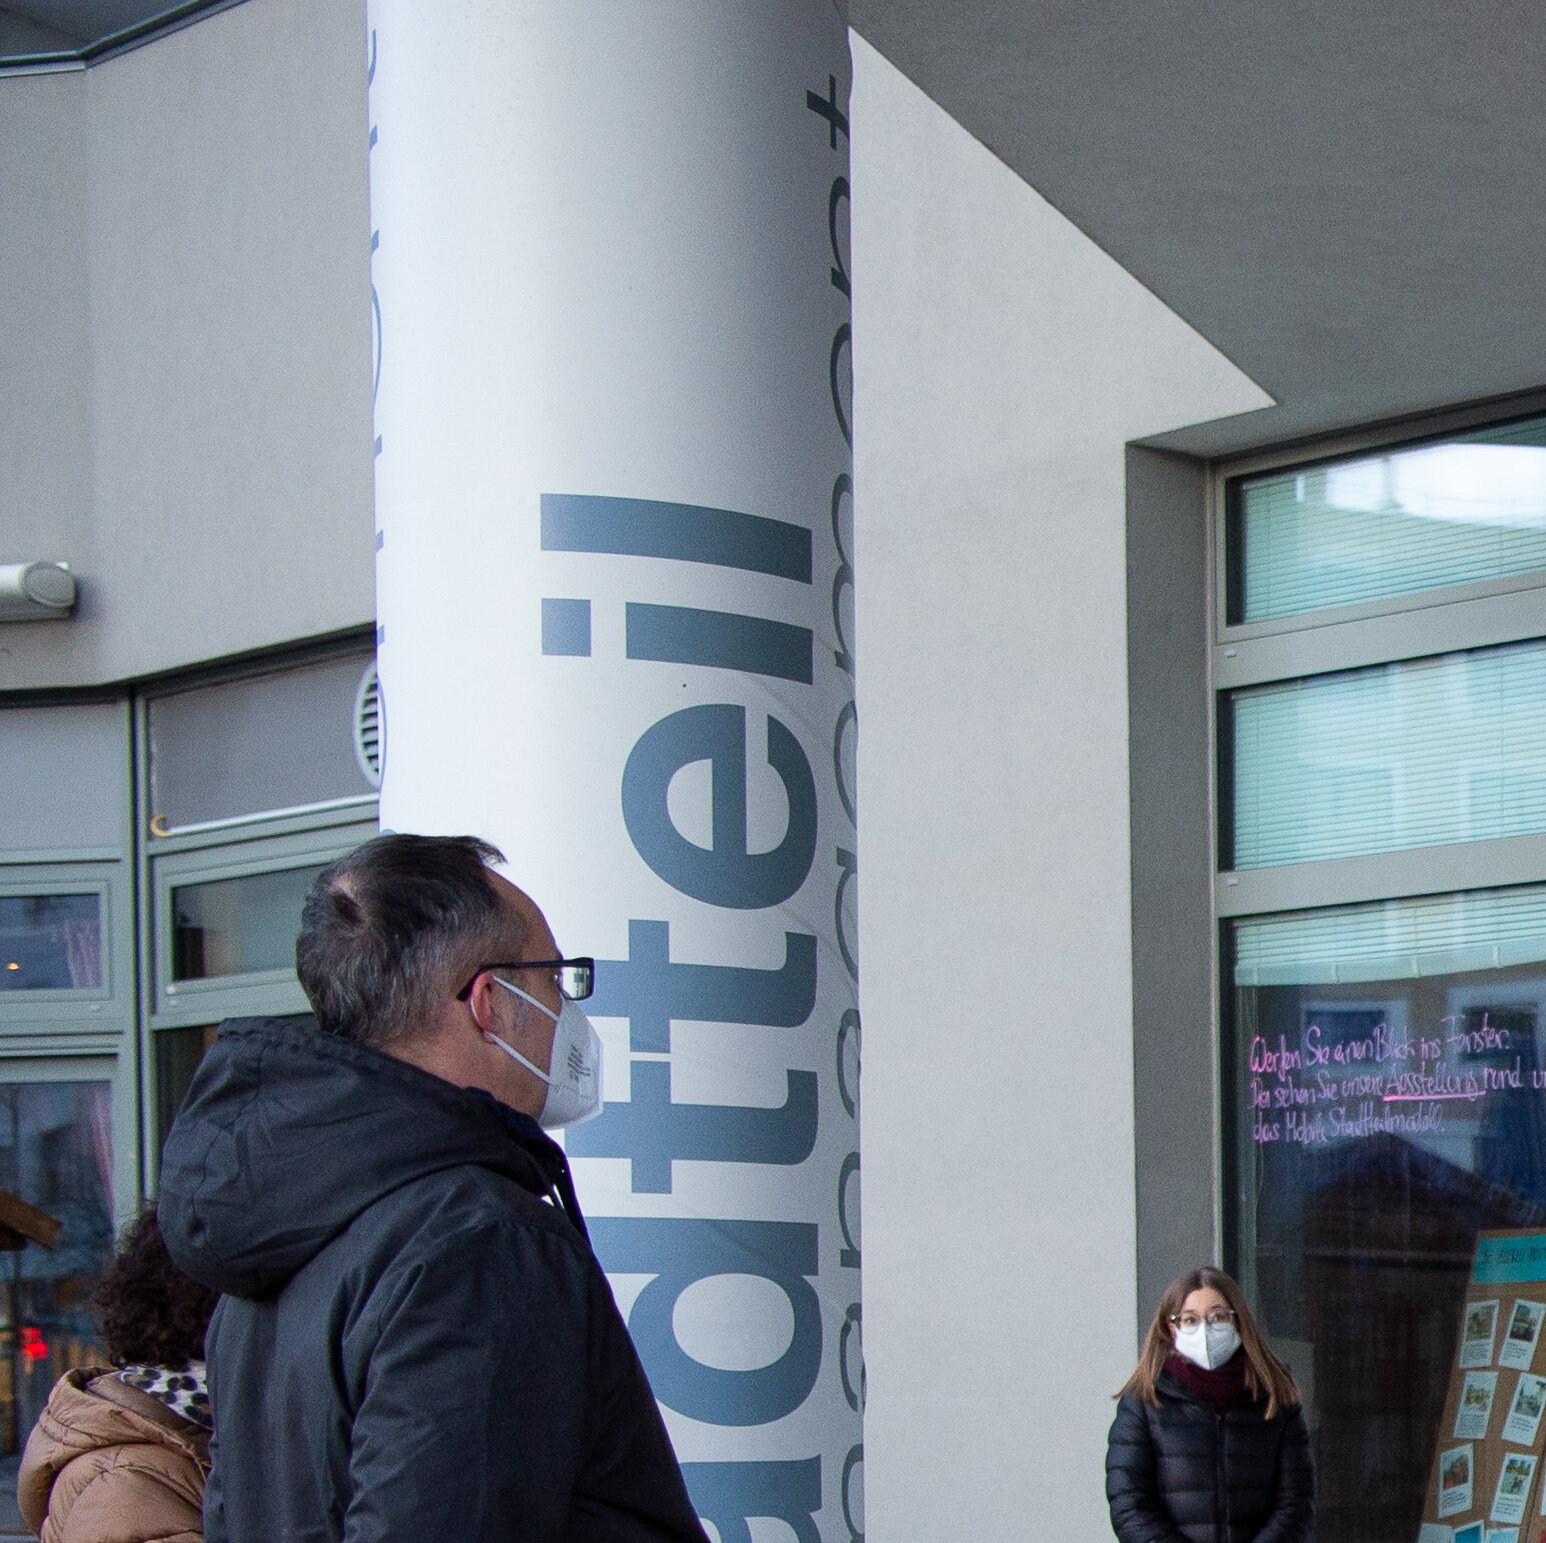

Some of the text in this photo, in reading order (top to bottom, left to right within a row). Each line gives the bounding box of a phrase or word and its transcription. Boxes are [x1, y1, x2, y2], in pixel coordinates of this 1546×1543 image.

[1251, 1034, 1300, 1081] Werfen
[1482, 1055, 1525, 1089] rund
[1252, 1117, 1280, 1144] das
